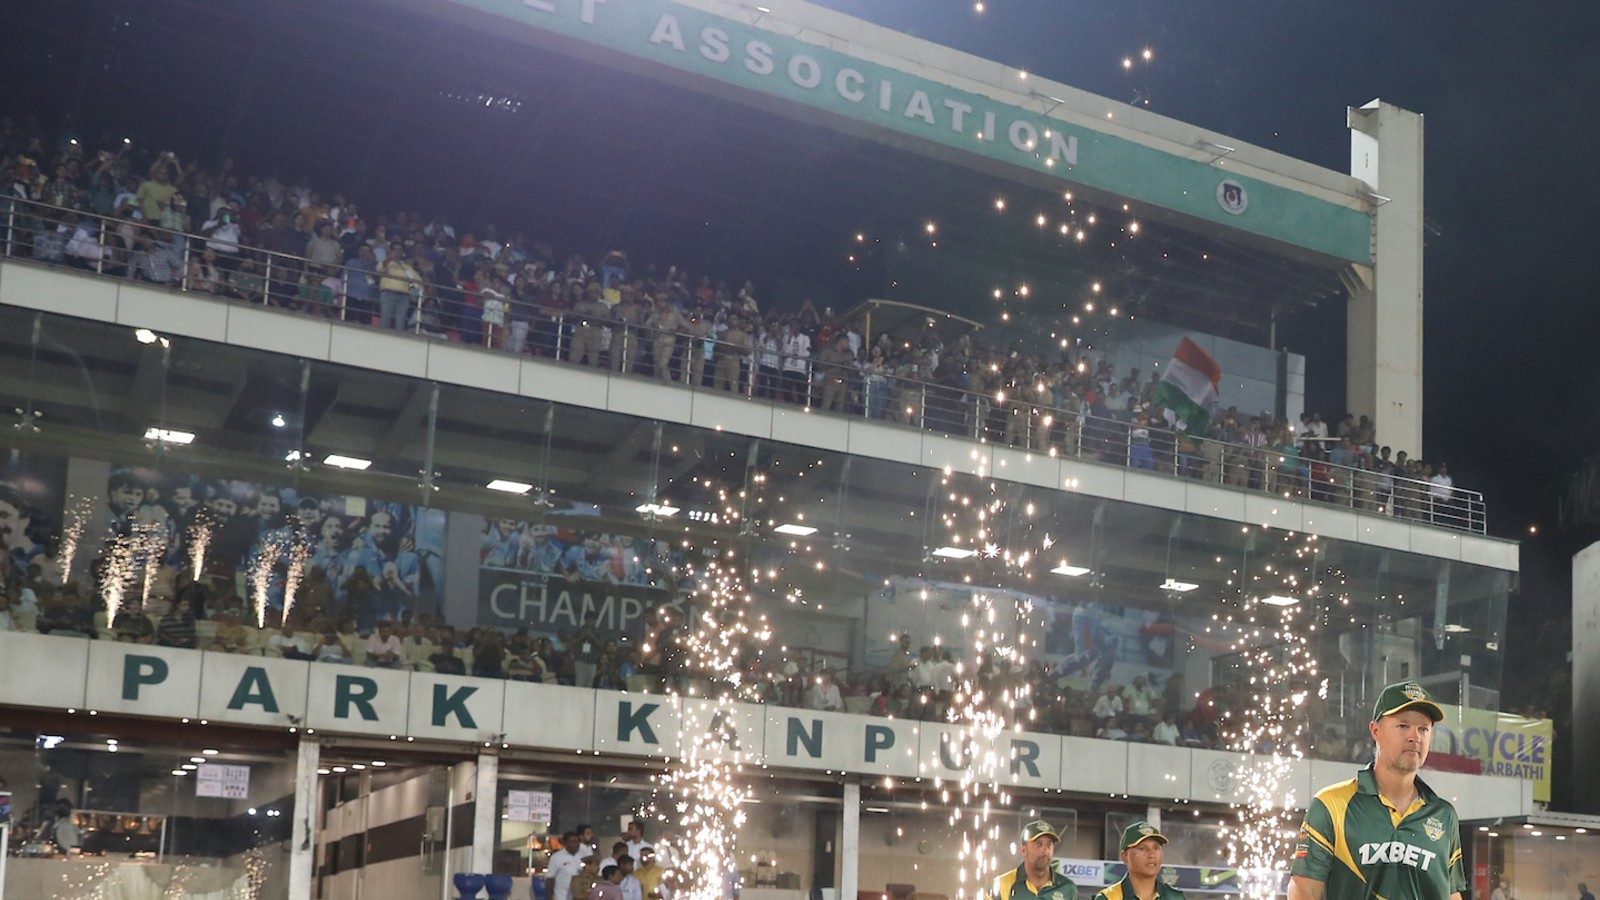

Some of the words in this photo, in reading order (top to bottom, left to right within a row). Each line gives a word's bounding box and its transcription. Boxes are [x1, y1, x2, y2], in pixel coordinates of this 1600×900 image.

[649, 13, 1079, 166] ASSOCIATION
[121, 653, 479, 730] PARK
[617, 700, 1041, 778] KANPUR
[1463, 726, 1545, 764] CYCLE
[1482, 761, 1544, 781] ARBATHI
[1063, 863, 1100, 877] 1XBET
[1358, 841, 1436, 872] 1XBET
